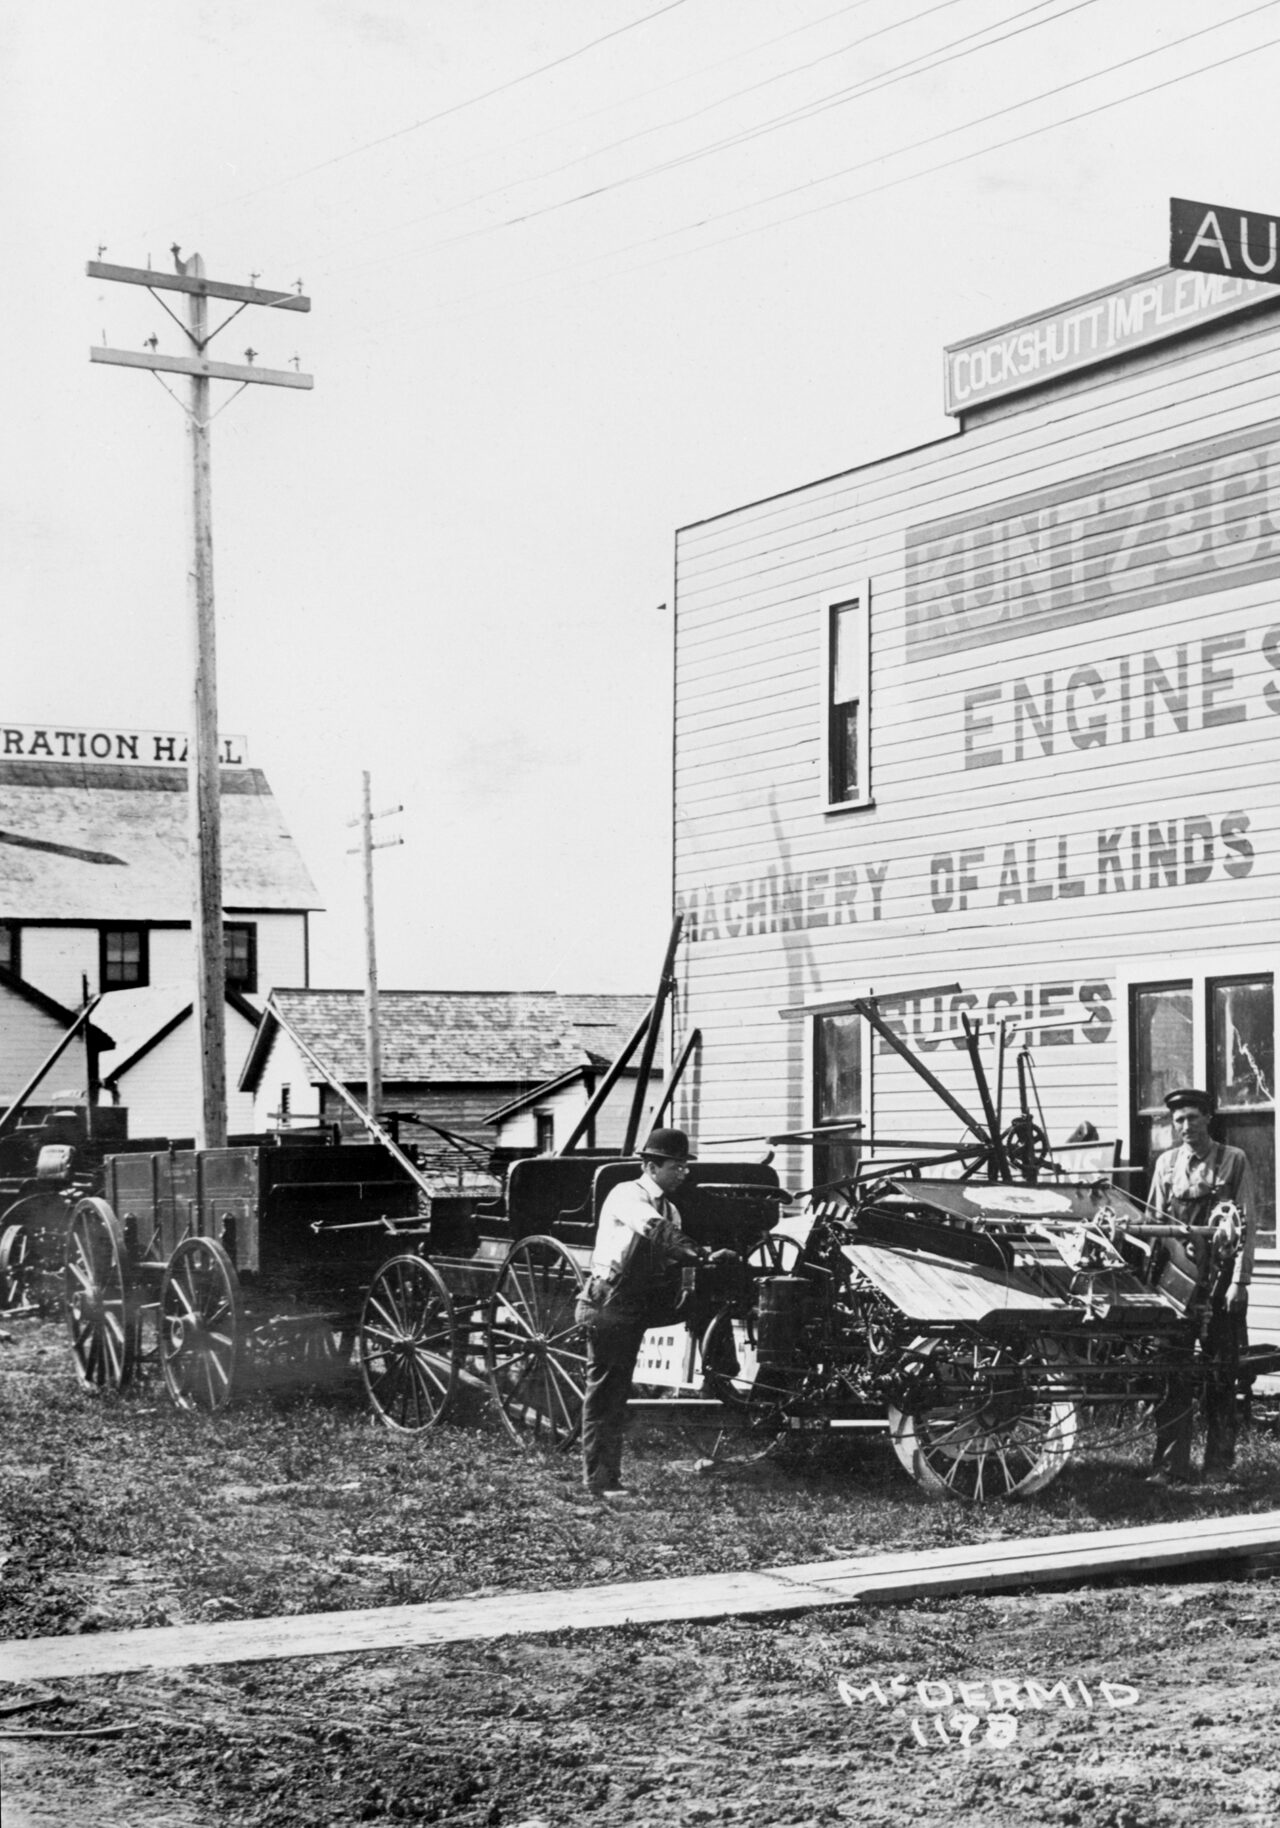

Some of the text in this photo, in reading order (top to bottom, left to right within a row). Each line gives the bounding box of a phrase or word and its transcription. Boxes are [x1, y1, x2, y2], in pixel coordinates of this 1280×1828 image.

[954, 271, 1257, 400] COCKSHUTT IMPLEME
[0, 728, 242, 764] RATION HL
[677, 810, 1254, 942] MACHINERY OF ALL KINDS
[879, 982, 1113, 1054] BUGGIES
